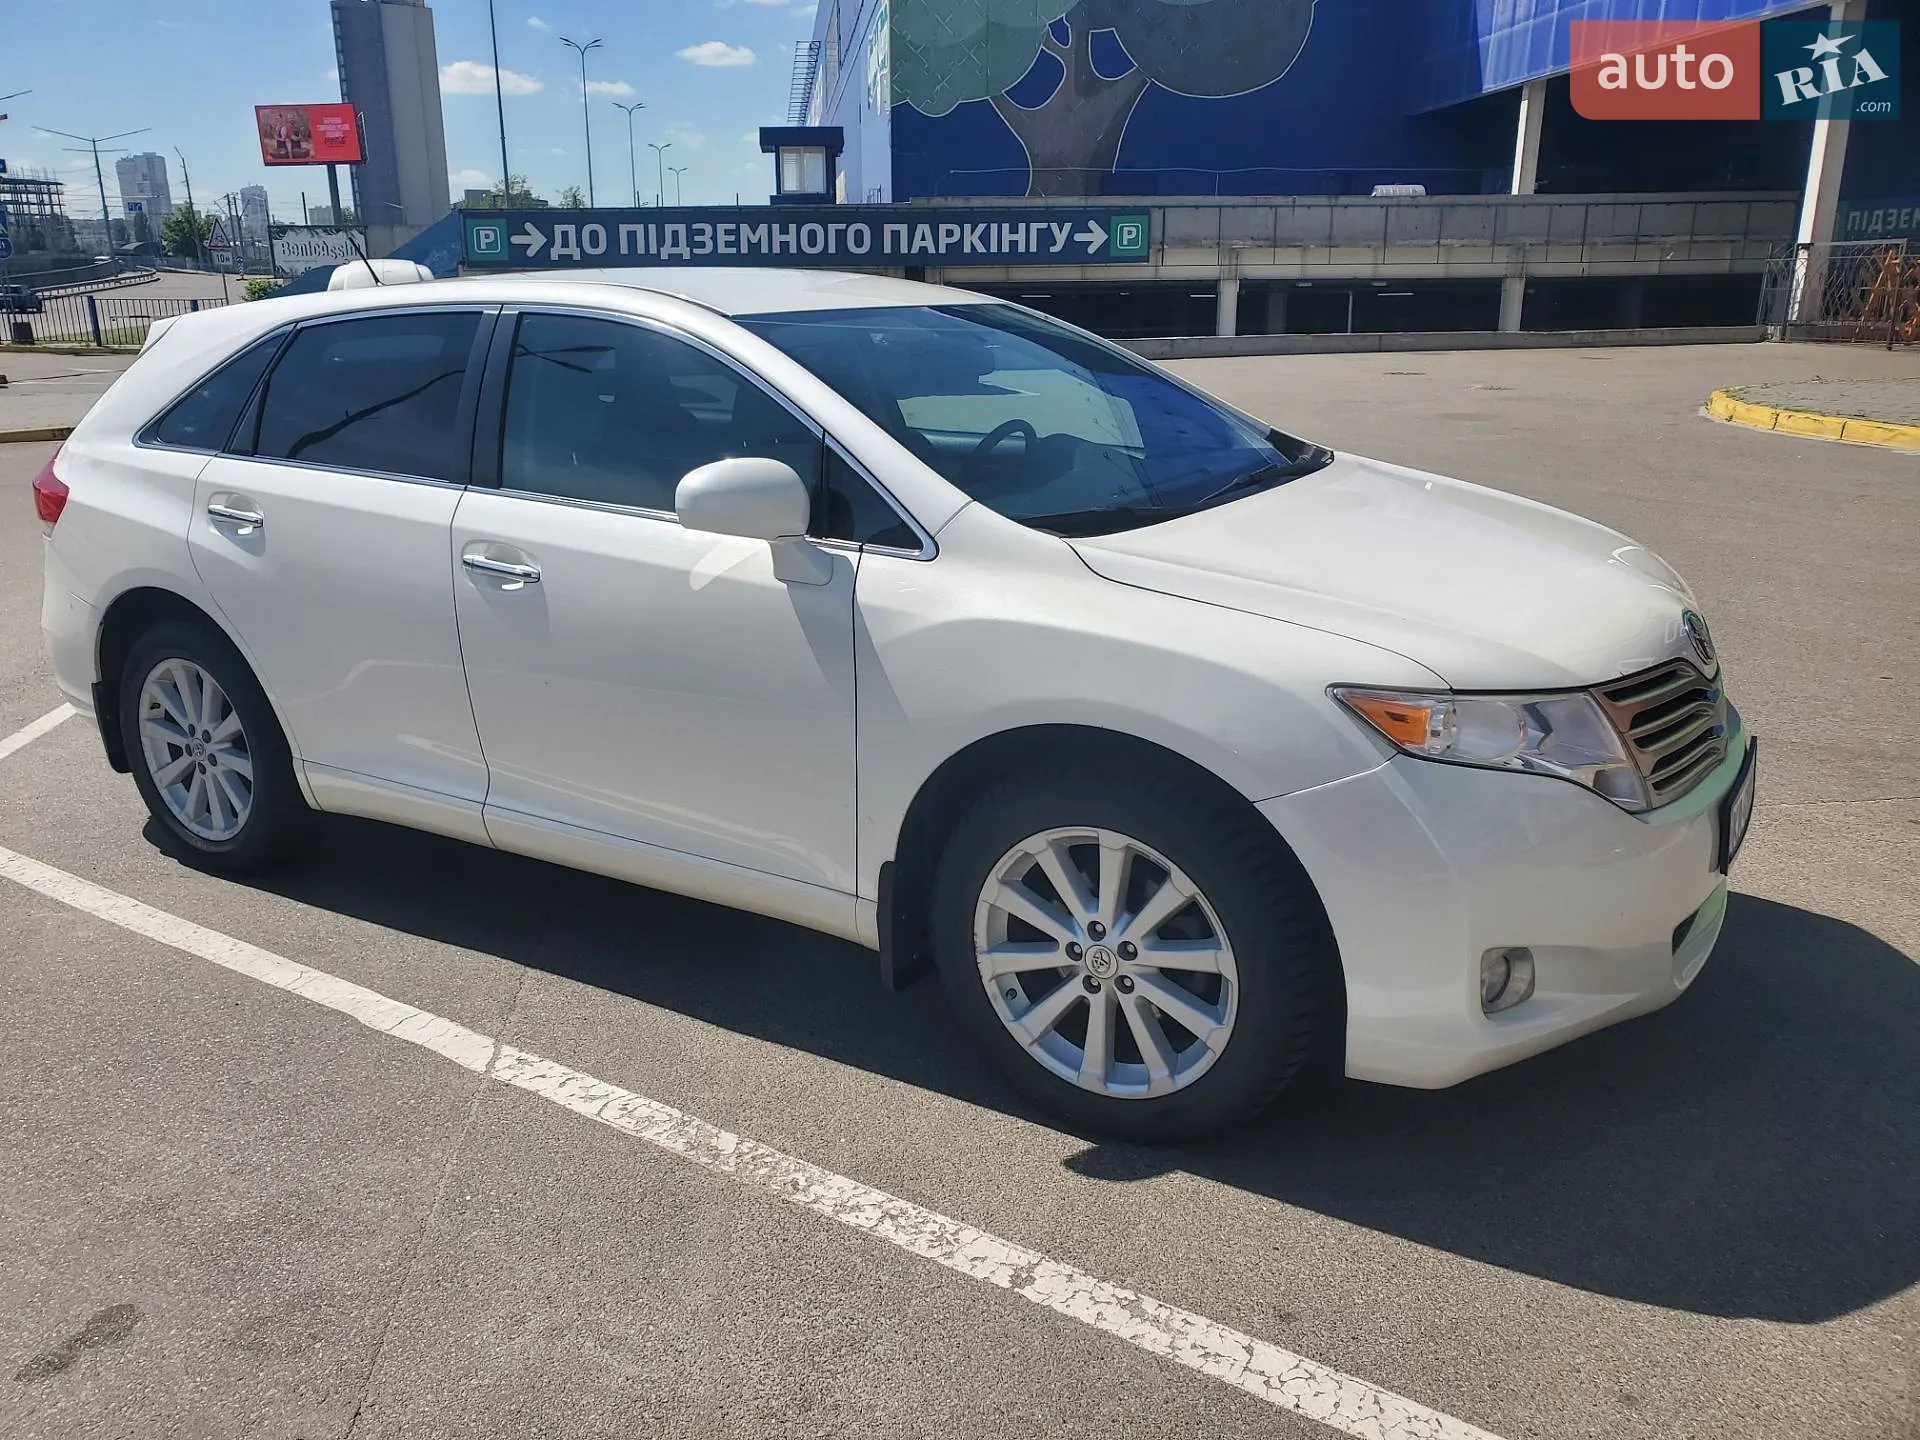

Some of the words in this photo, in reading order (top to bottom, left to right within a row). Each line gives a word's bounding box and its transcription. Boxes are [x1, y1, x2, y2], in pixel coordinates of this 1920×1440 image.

[550, 223, 606, 260] ДО
[619, 222, 872, 259] ПІДЗЕМНОГО
[884, 222, 1072, 254] ПАРКІНГУ
